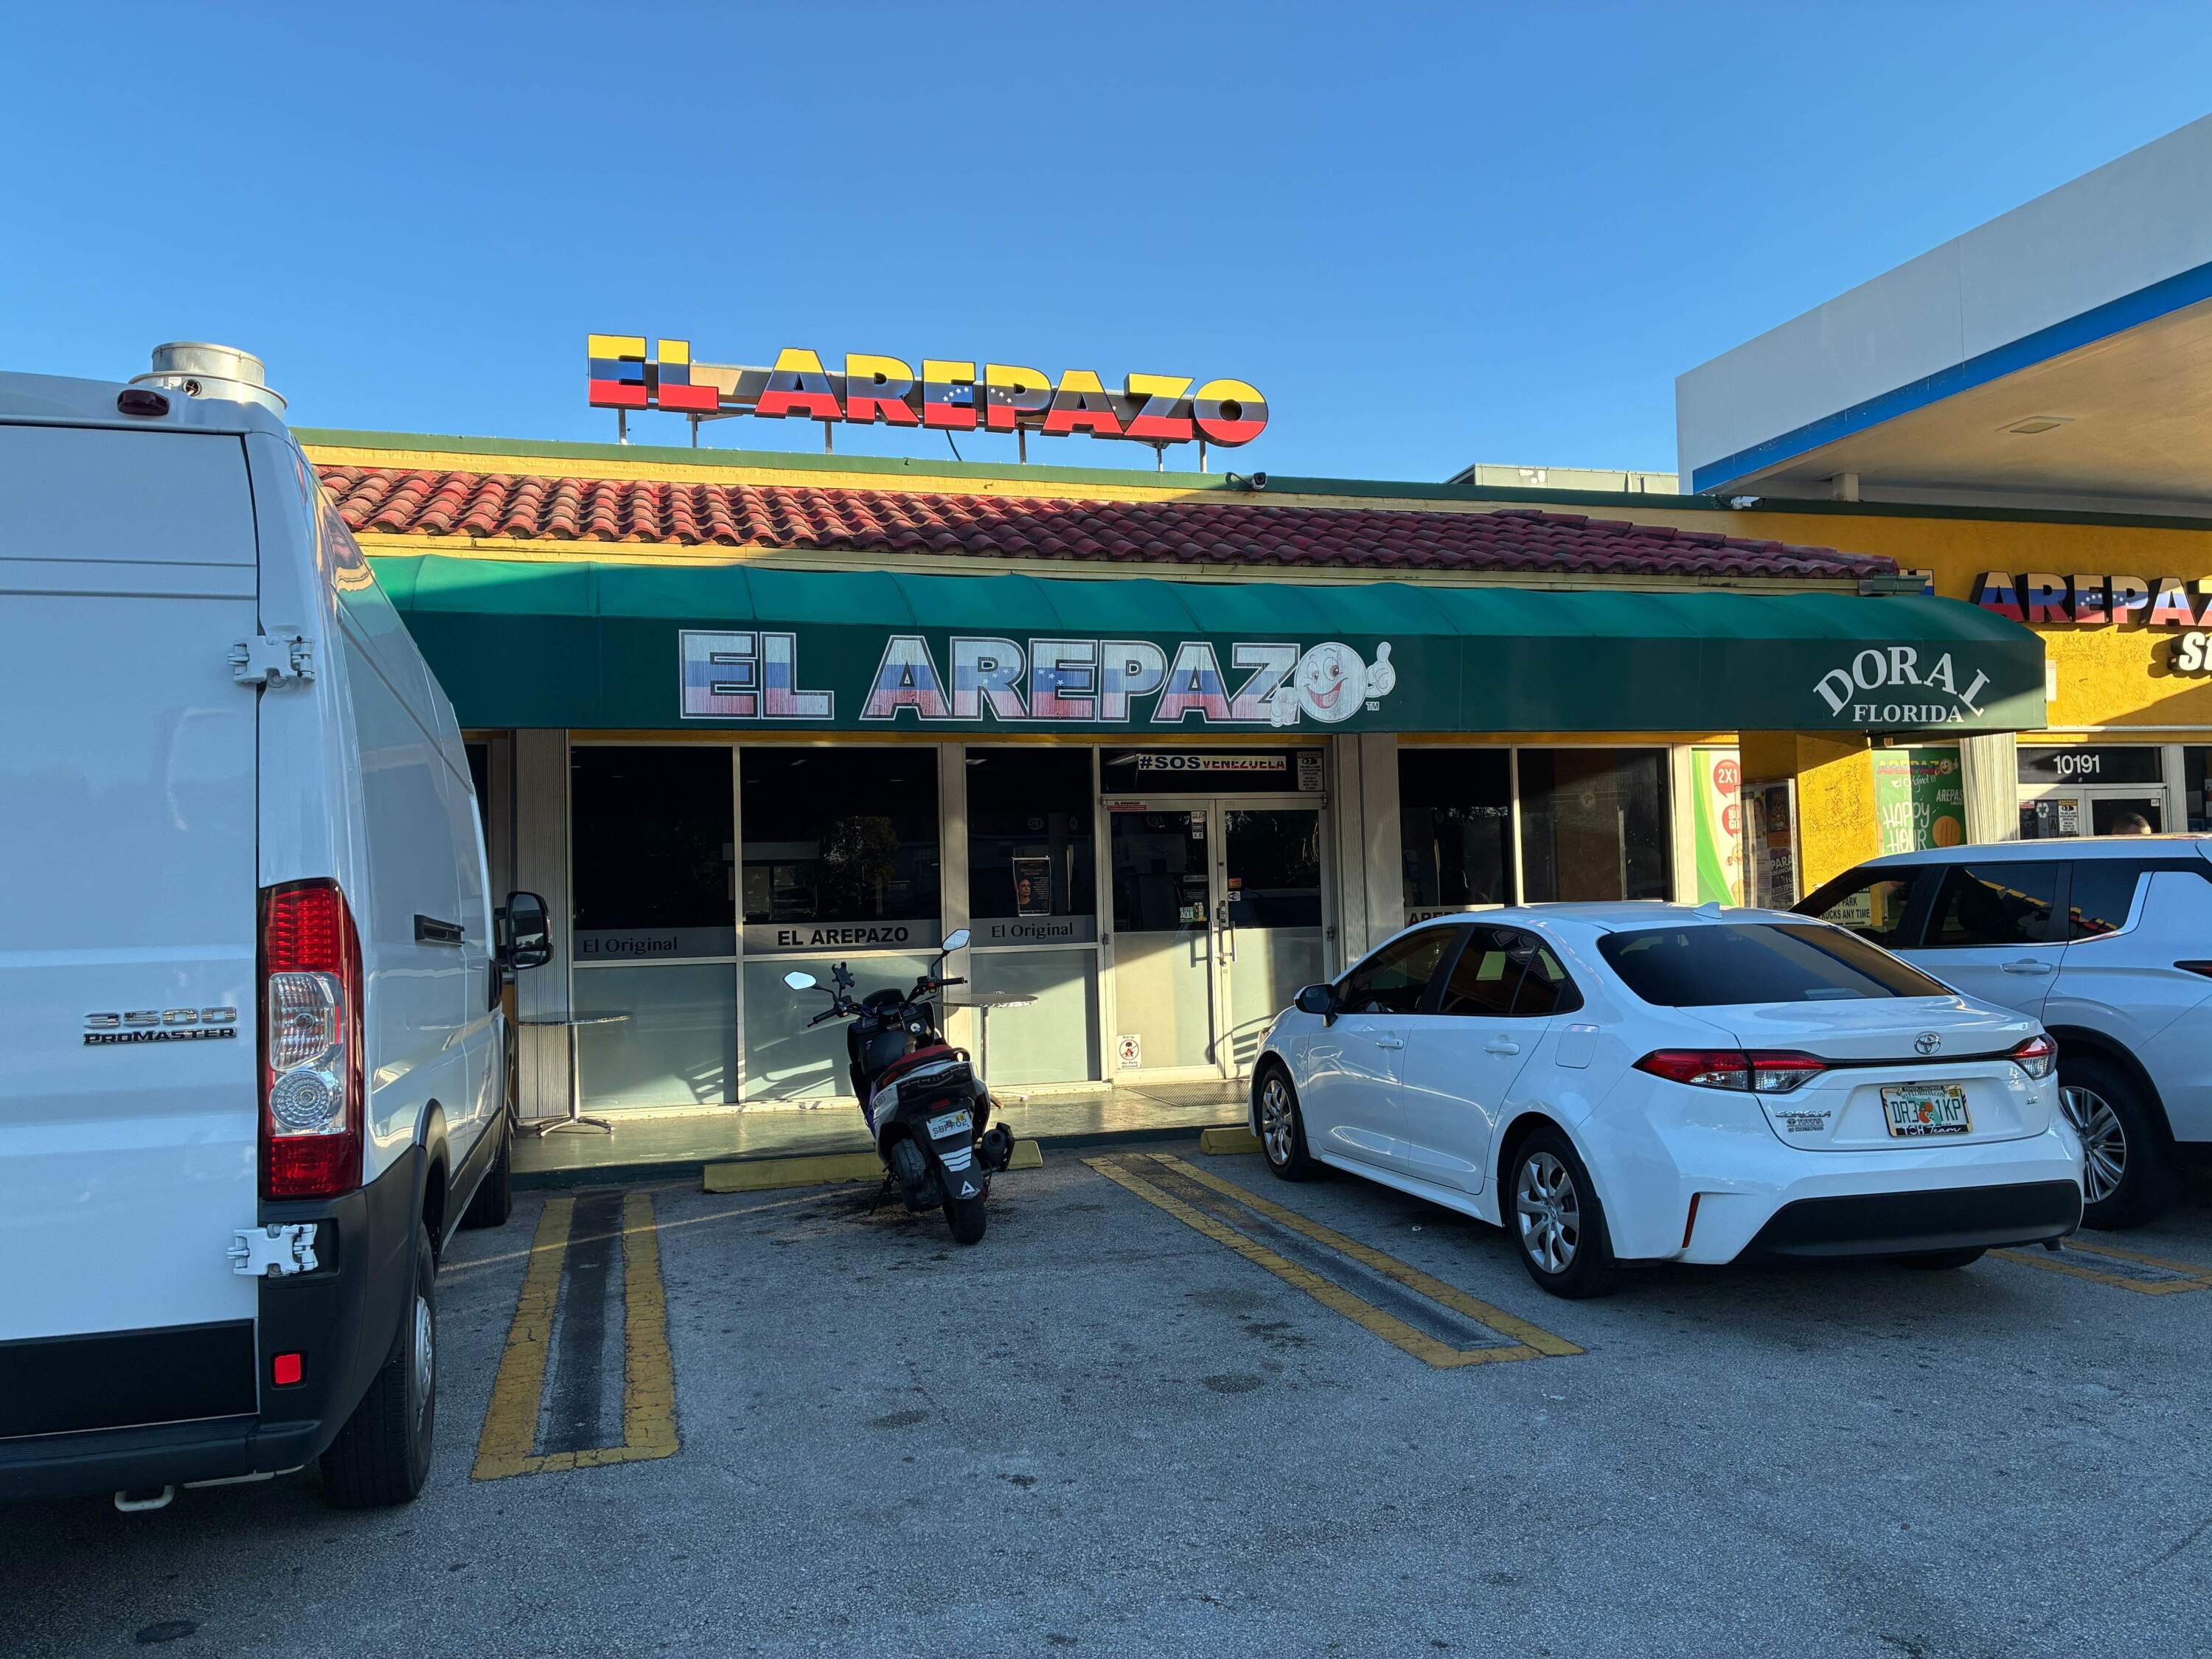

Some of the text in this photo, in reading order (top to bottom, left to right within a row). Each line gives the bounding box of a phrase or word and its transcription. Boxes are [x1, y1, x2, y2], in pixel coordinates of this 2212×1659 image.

[588, 334, 1269, 447] EL AREPAZO
[679, 630, 834, 720] EL
[1366, 701, 1380, 711] TM
[1812, 646, 1990, 717] DORAL
[1852, 704, 1964, 723] FLORIDA
[2053, 754, 2100, 774] 10191
[1820, 908, 1871, 920] RUCKS ANY TIME
[778, 927, 908, 946] EL AREPAZO
[992, 922, 1073, 939] El Original
[583, 936, 678, 955] El Original
[83, 1006, 237, 1029] 3500
